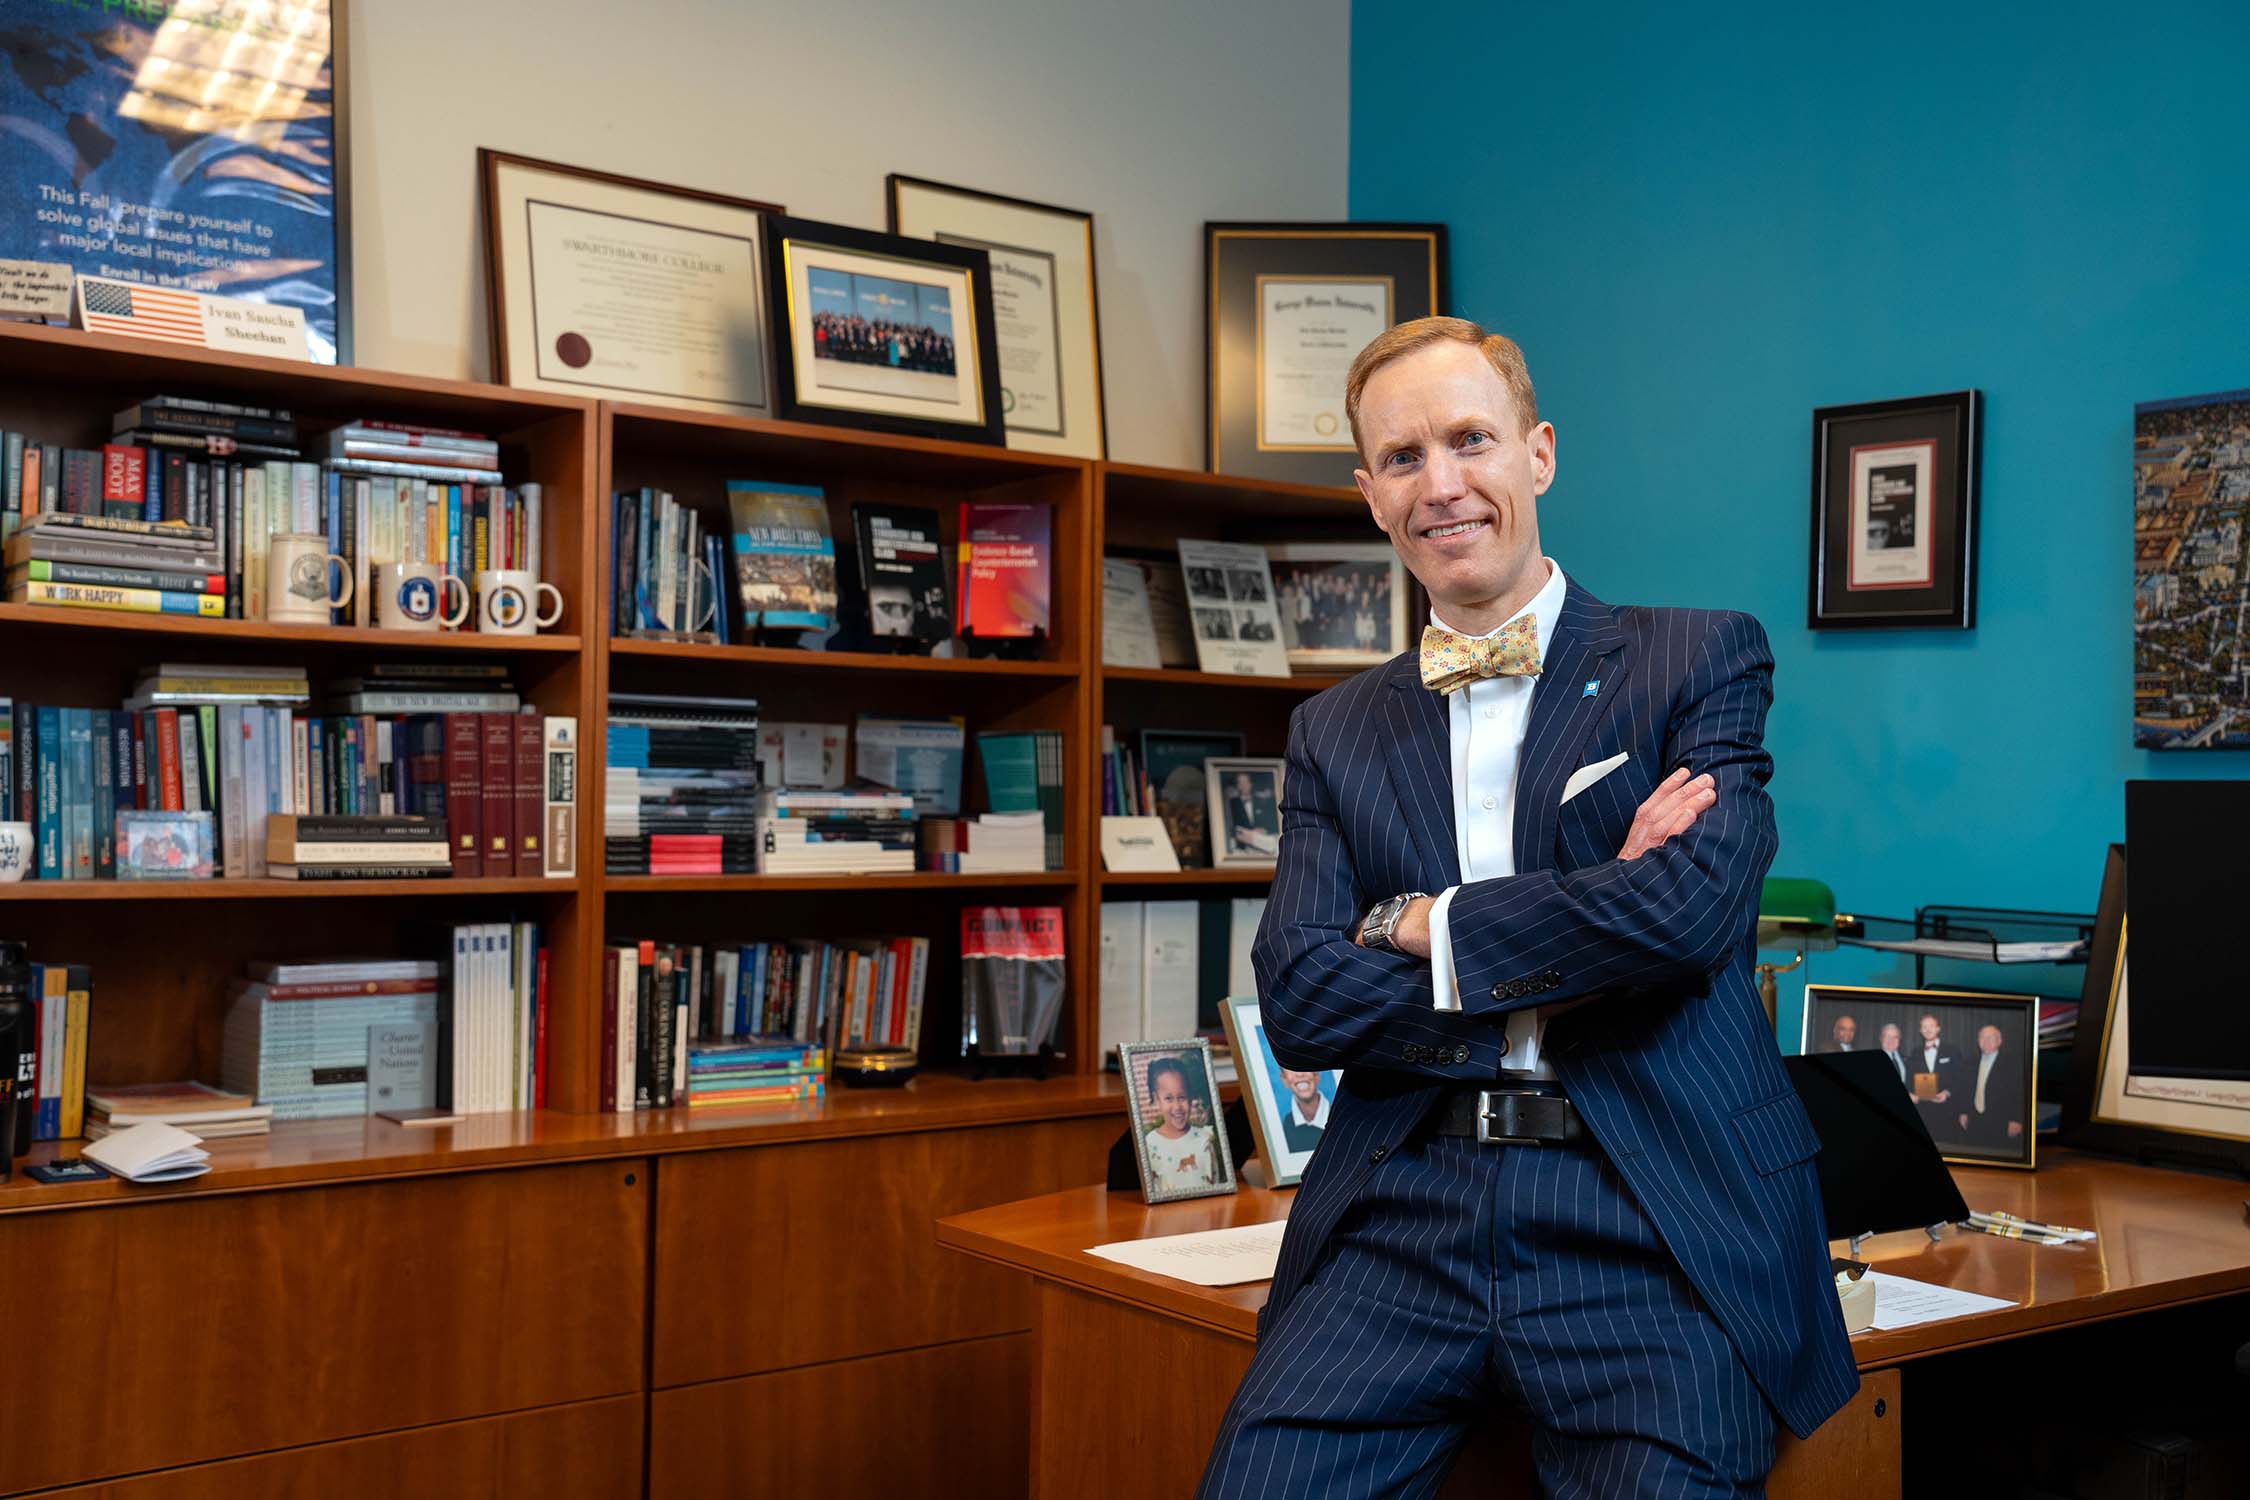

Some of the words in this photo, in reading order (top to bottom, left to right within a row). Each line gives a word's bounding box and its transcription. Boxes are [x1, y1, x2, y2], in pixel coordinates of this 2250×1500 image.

[38, 185, 75, 203] This
[79, 193, 112, 212] Fall,
[119, 202, 185, 223] prepare
[188, 213, 251, 235] yourself
[255, 222, 273, 238] to
[37, 208, 82, 227] solve
[87, 215, 139, 237] global
[144, 224, 193, 244] issues
[196, 231, 229, 250] that
[233, 235, 271, 257] have
[59, 231, 108, 253] major
[112, 239, 152, 259] local
[100, 265, 141, 283] Enroll
[143, 271, 156, 283] in
[159, 273, 181, 288] the
[208, 305, 241, 321] Ivan
[247, 311, 296, 329] Sascha
[225, 327, 287, 345] Sheehan
[109, 452, 124, 497] BOOT
[127, 457, 141, 495] MAX
[85, 587, 123, 604] HAPPY
[22, 728, 32, 791] NEGOTIATING
[119, 727, 130, 787] NEGOTIATION
[658, 1038, 670, 1082] POWELL
